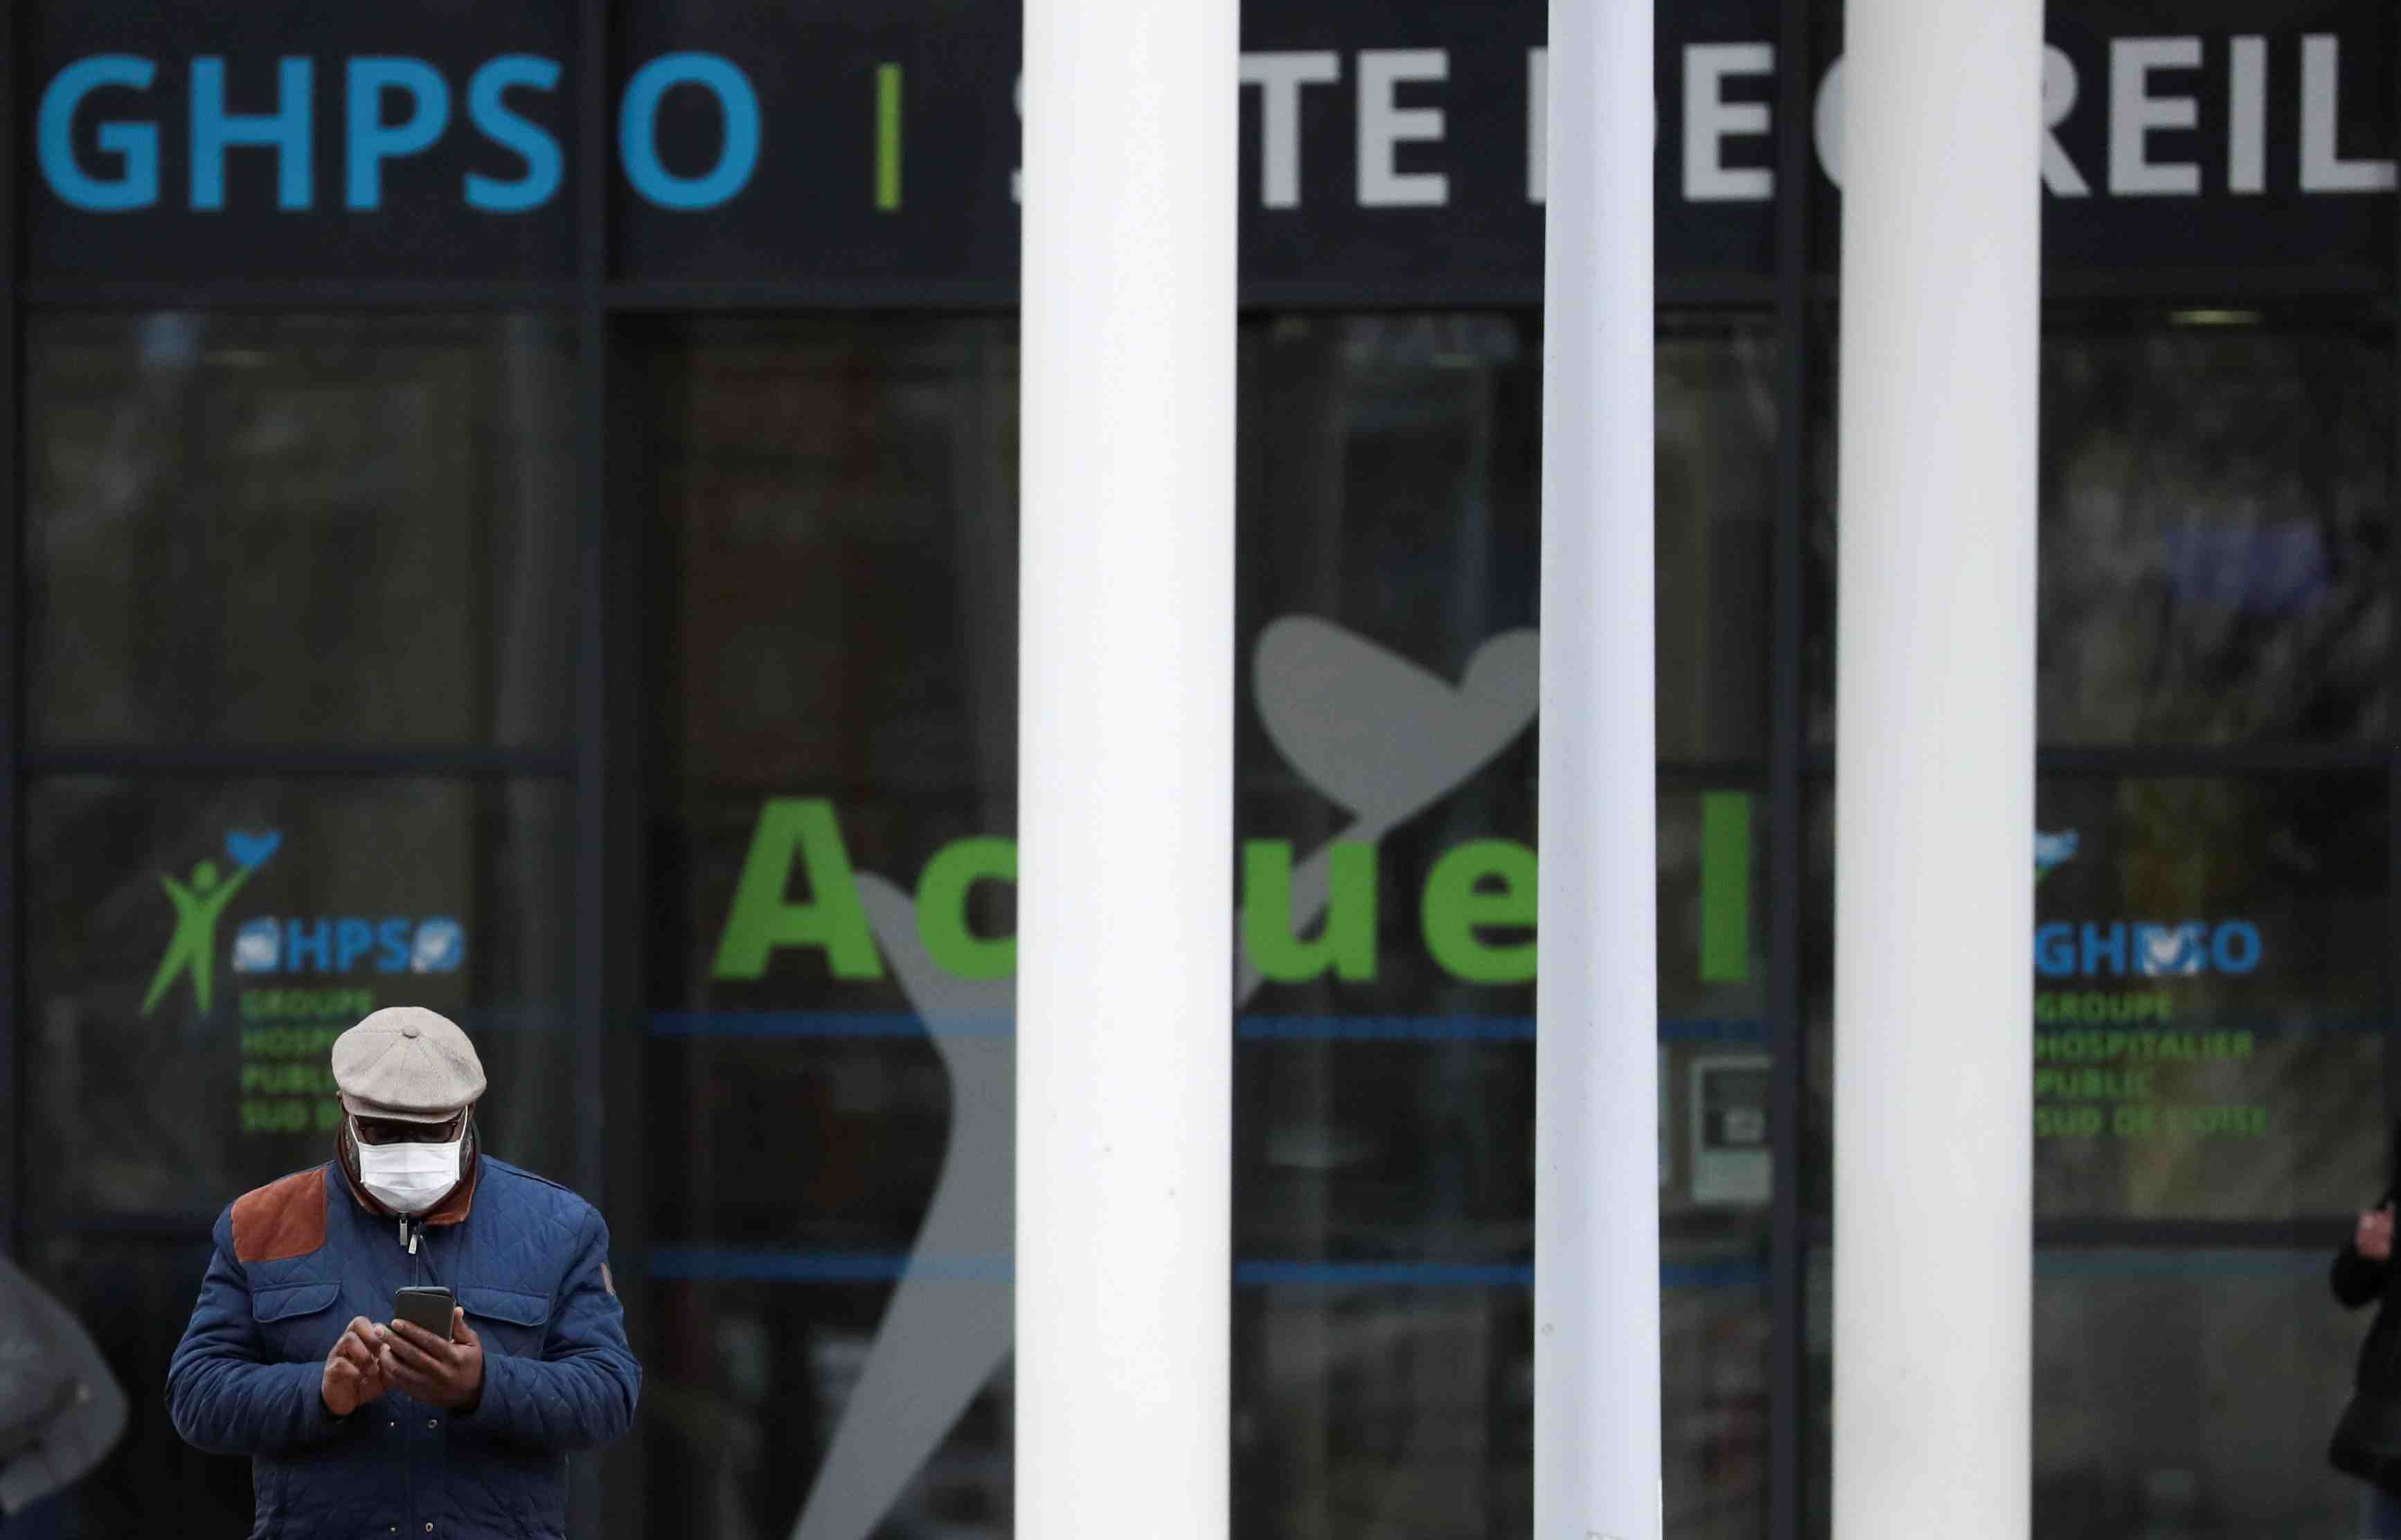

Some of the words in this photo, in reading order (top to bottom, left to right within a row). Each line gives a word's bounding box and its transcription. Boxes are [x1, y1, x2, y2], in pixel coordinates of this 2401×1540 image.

[37, 52, 761, 211] GHPSO
[1011, 48, 1341, 208] TE
[1527, 43, 1773, 202] E
[712, 791, 1752, 984] Acuel
